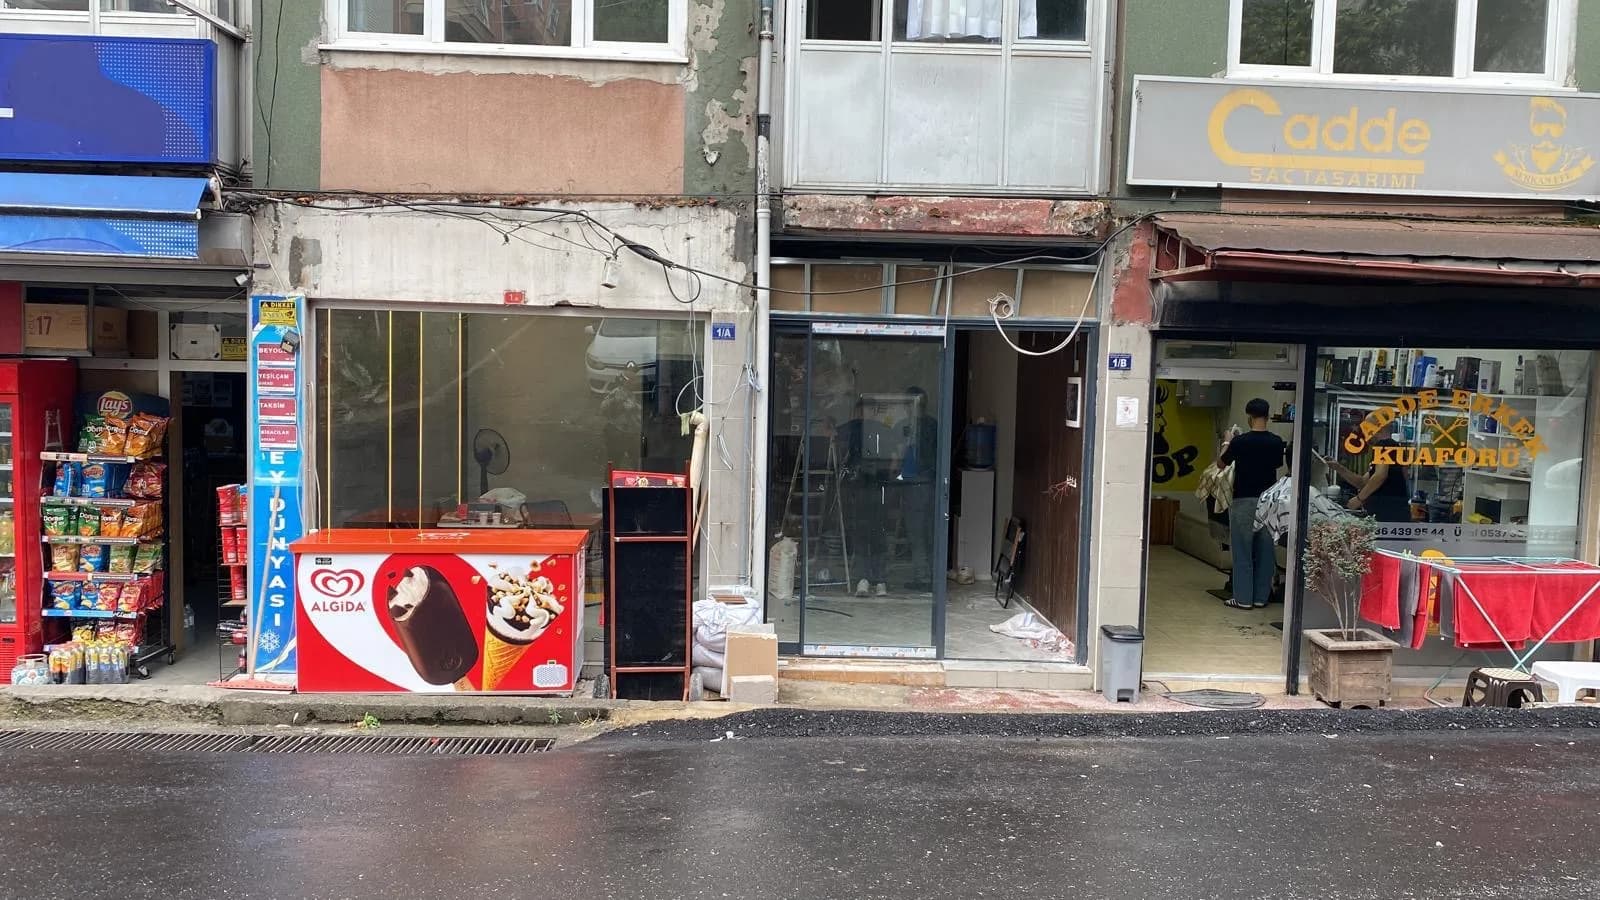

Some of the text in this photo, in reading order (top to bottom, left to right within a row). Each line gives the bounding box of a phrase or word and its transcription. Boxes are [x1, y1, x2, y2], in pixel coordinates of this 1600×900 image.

[1207, 88, 1432, 170] Cadde
[36, 315, 53, 336] 17
[716, 327, 732, 338] 1/A
[1112, 357, 1128, 368] 1/B
[1343, 389, 1550, 460] CADDE ERKEK
[1152, 444, 1199, 484] OP
[1371, 441, 1522, 468] KUAFÖRÜ
[1390, 527, 1412, 536] 439
[1430, 527, 1446, 537] 44
